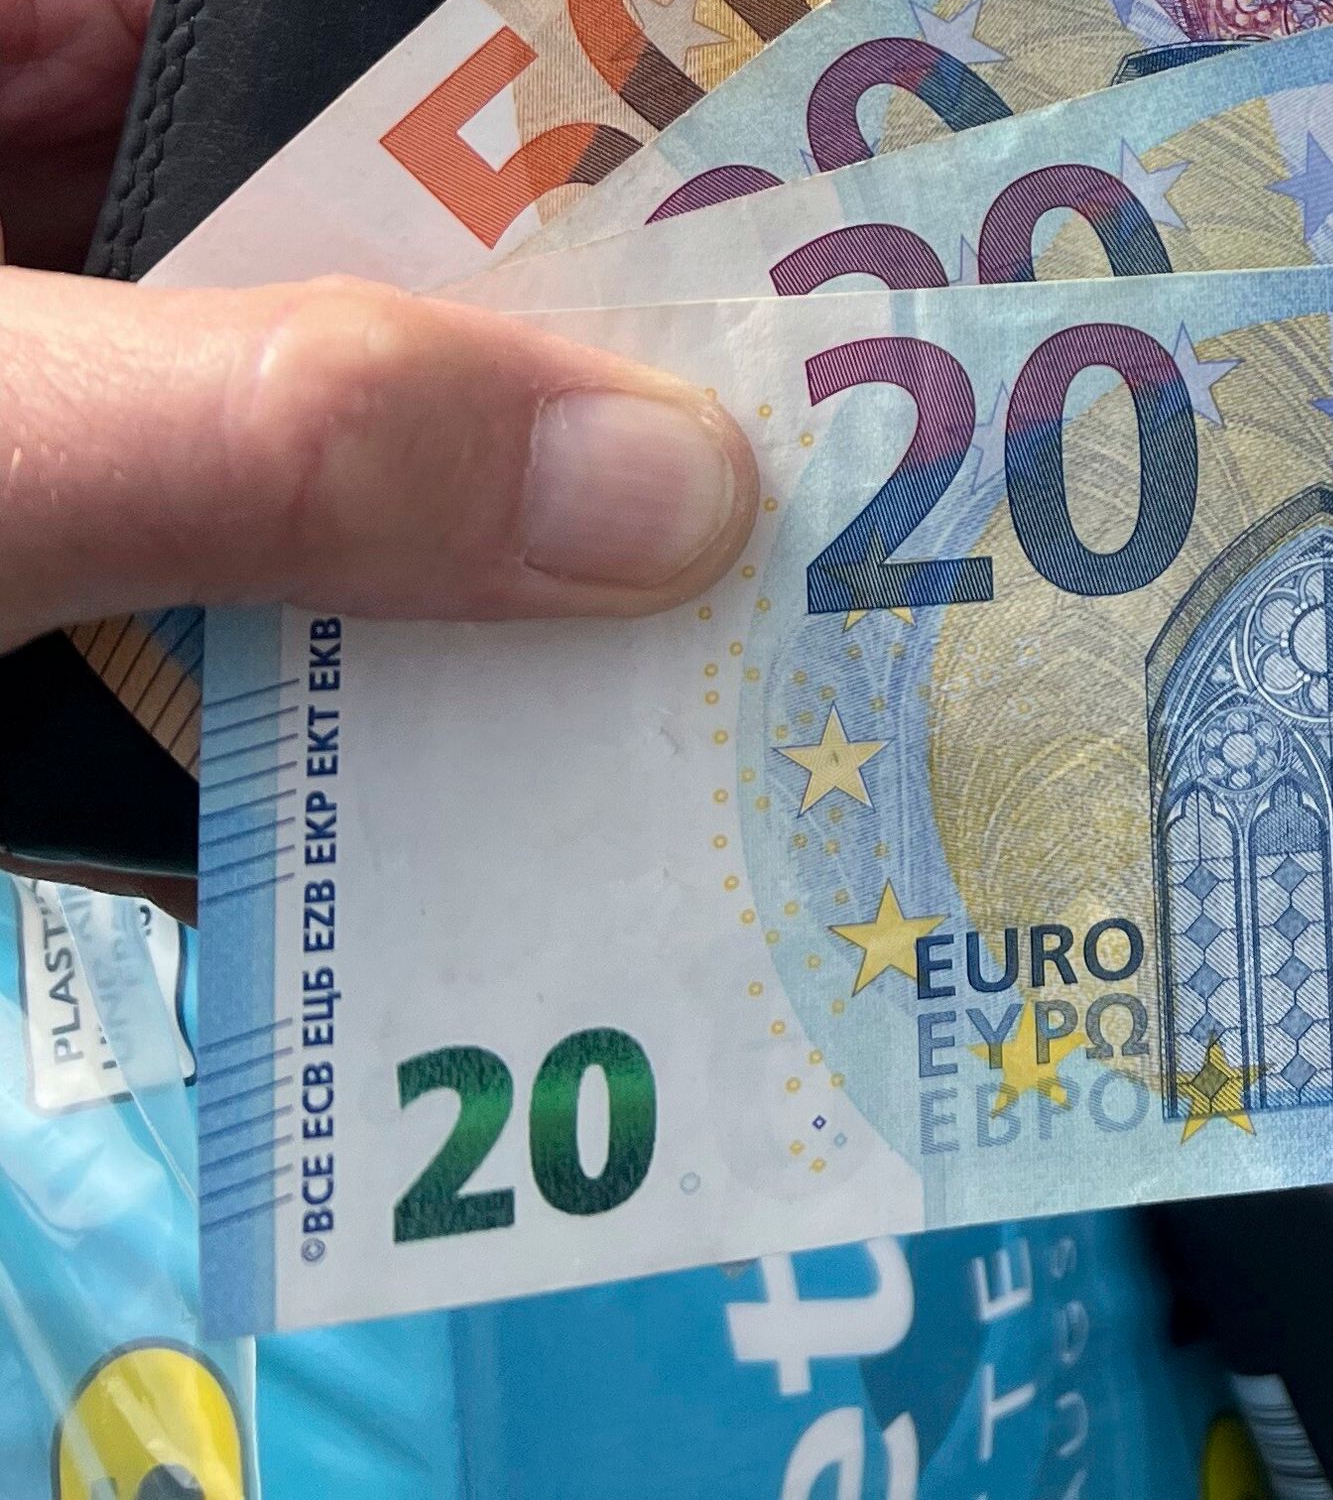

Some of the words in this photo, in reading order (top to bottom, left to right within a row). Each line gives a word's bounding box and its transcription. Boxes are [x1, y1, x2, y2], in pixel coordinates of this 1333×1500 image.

[805, 322, 1199, 615] 20
[308, 616, 342, 693] EKB
[306, 705, 340, 779] EKT
[304, 790, 338, 866] EKP
[303, 878, 336, 952] EZB
[915, 917, 1145, 1001] EURO
[302, 966, 342, 1048] ЕЦБ
[302, 1060, 335, 1139] ECB
[393, 1026, 659, 1245] 20
